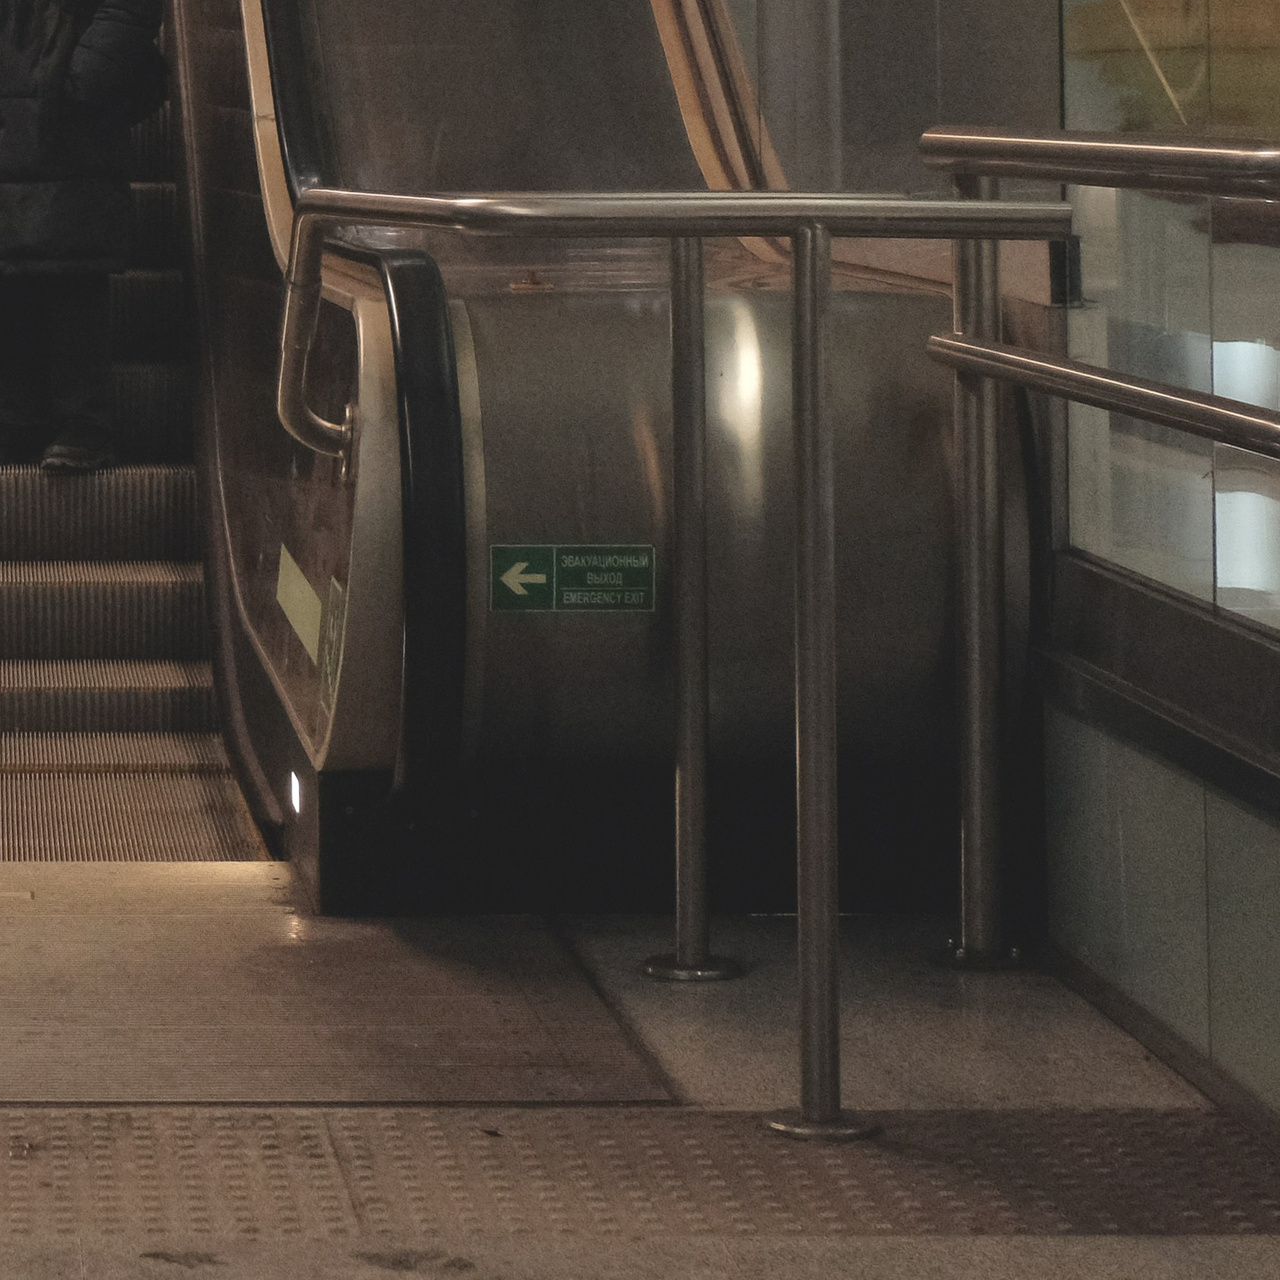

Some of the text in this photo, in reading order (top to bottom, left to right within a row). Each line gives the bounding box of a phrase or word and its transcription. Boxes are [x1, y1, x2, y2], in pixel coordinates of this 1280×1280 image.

[561, 554, 649, 568] ЭВАКУАЦИОННЫЙ
[587, 573, 623, 585] ВЫХОД
[563, 592, 645, 604] EMERGENCY EXIT
